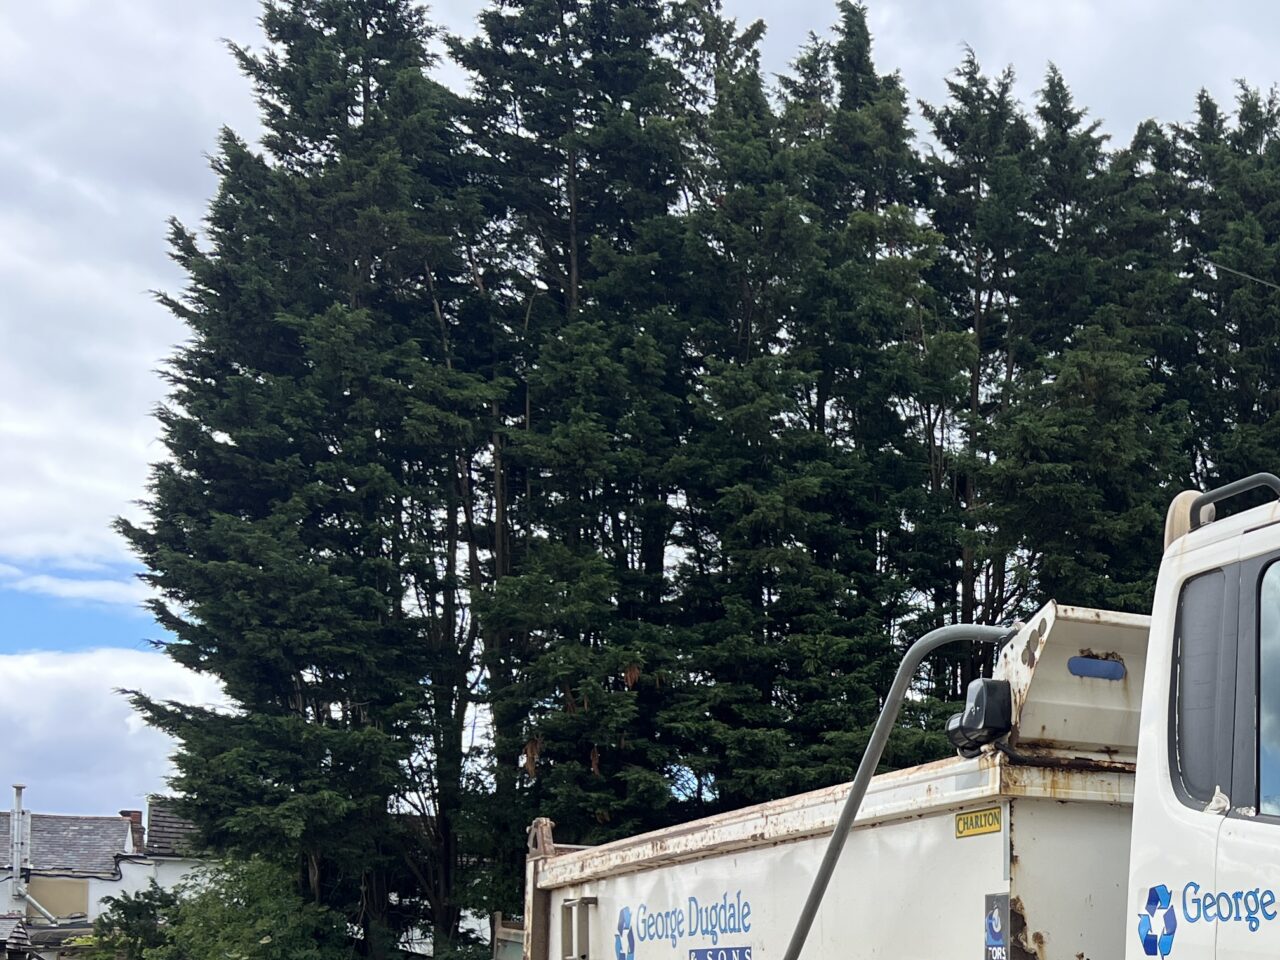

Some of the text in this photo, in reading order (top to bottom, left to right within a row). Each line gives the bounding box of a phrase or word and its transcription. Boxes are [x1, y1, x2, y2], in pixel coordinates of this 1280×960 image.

[957, 811, 1000, 835] CHARLTON
[636, 889, 752, 949] George Dugdale
[1182, 881, 1278, 932] George
